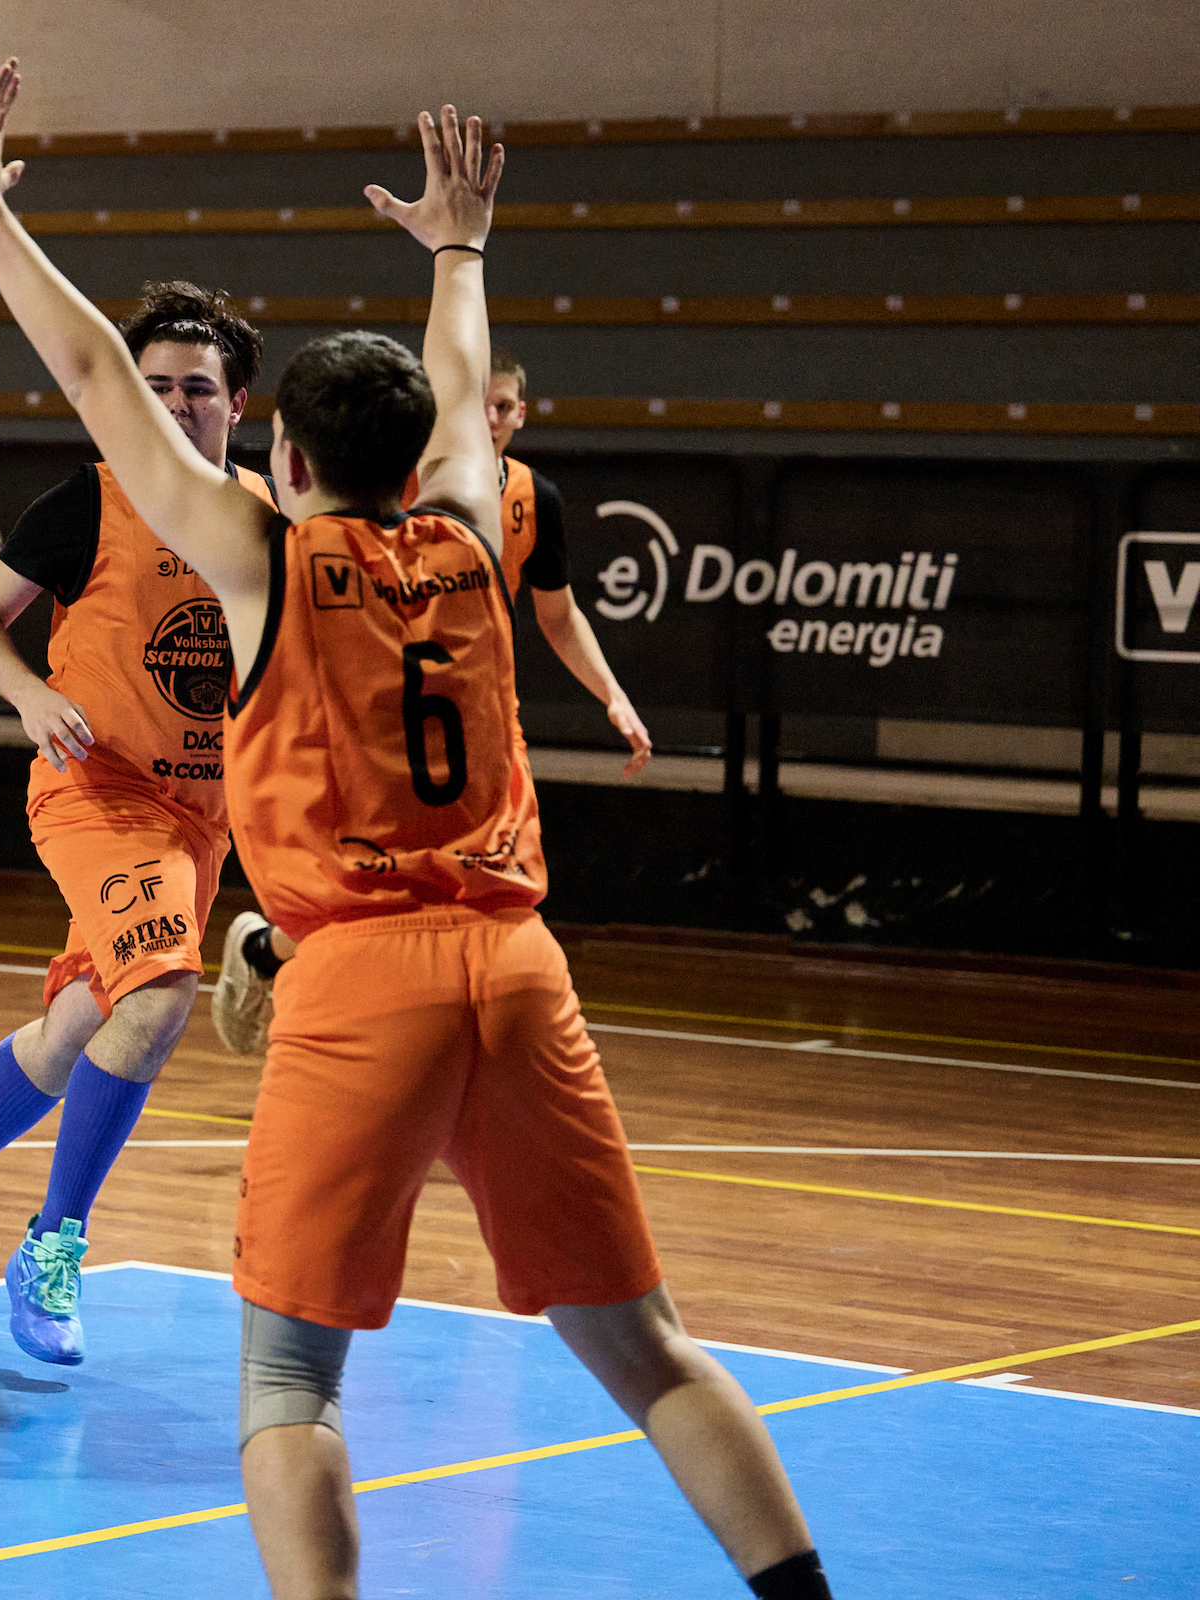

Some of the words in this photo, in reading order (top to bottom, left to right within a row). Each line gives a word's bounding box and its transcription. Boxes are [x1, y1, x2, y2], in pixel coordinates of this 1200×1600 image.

[512, 501, 523, 534] 9
[684, 544, 959, 610] Dolomiti
[766, 615, 944, 668] energia
[144, 650, 224, 668] SCHOOL
[403, 640, 465, 806] 6
[134, 914, 187, 944] ITAS
[140, 937, 180, 953] MUTUA
